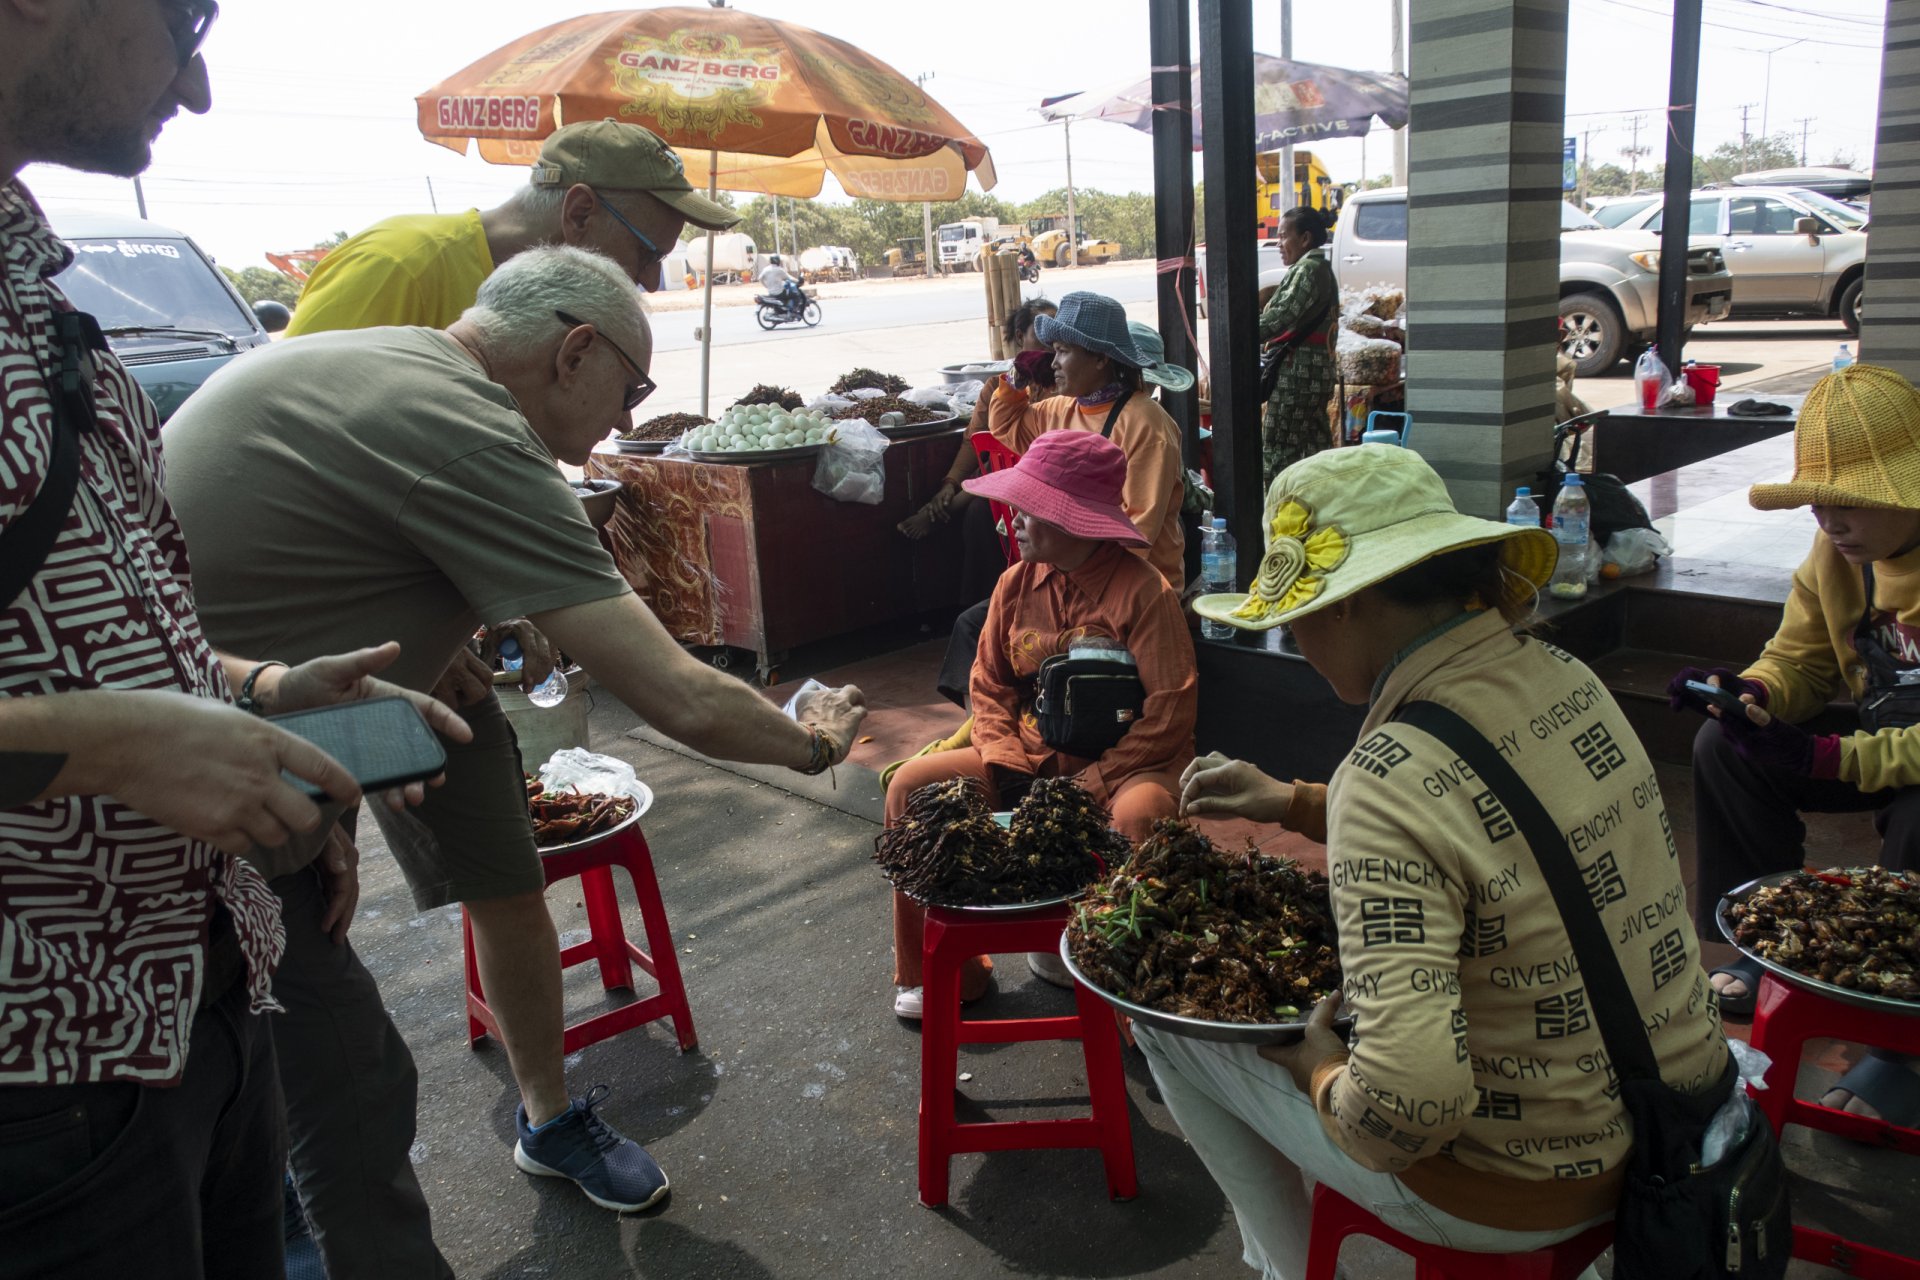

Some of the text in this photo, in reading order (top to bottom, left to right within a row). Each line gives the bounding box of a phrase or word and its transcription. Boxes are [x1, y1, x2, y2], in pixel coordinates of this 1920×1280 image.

[618, 51, 780, 81] GANZBERG
[438, 96, 540, 130] GANZBERG
[1529, 678, 1606, 741] GIVENCHY
[1564, 773, 1660, 854] ENCHY GIVE
[1332, 857, 1450, 890] GIVENCHY
[1489, 952, 1580, 989] GIVENC
[1472, 1055, 1552, 1081] ENCHY
